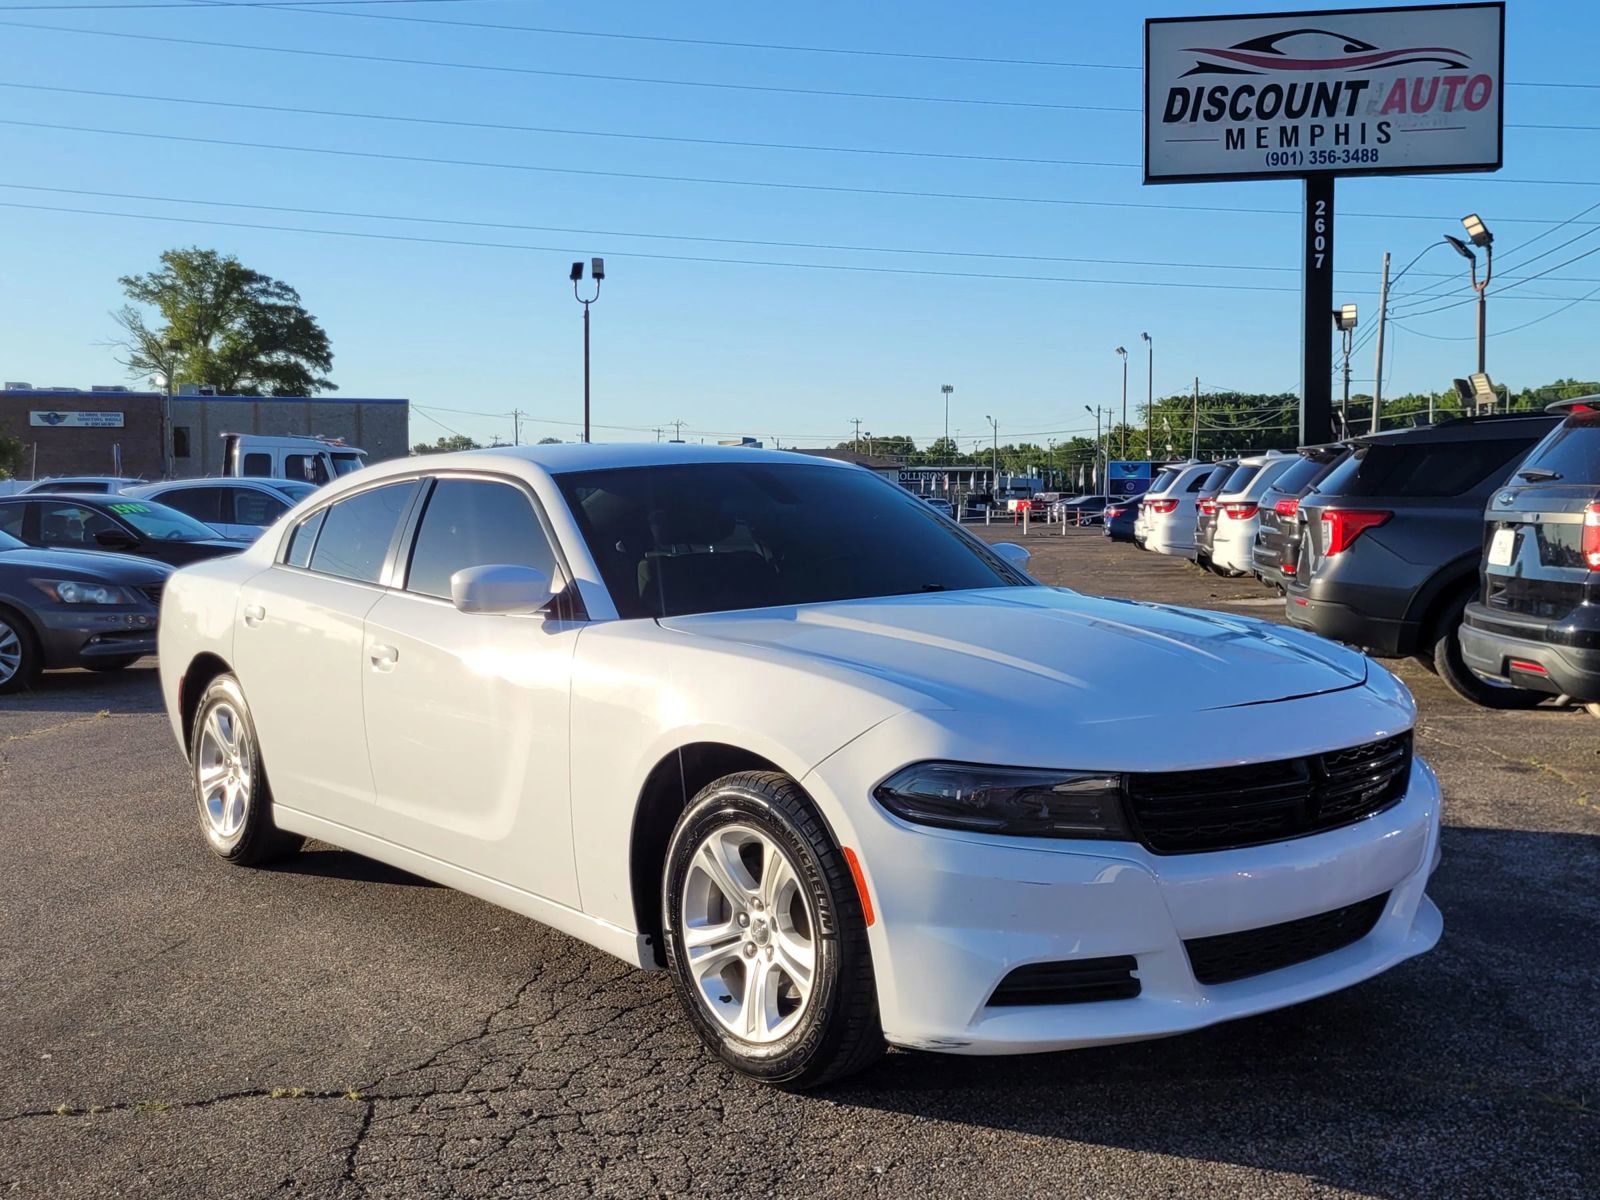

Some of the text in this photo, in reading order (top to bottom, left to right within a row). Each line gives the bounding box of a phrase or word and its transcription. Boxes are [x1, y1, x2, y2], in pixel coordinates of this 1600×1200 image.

[1162, 74, 1493, 123] DISCOUNT AUTO
[1225, 121, 1391, 150] MEMPHIS
[1266, 148, 1379, 167] (901) 356-3488
[1314, 200, 1326, 269] 2607
[898, 471, 947, 481] OLLISION
